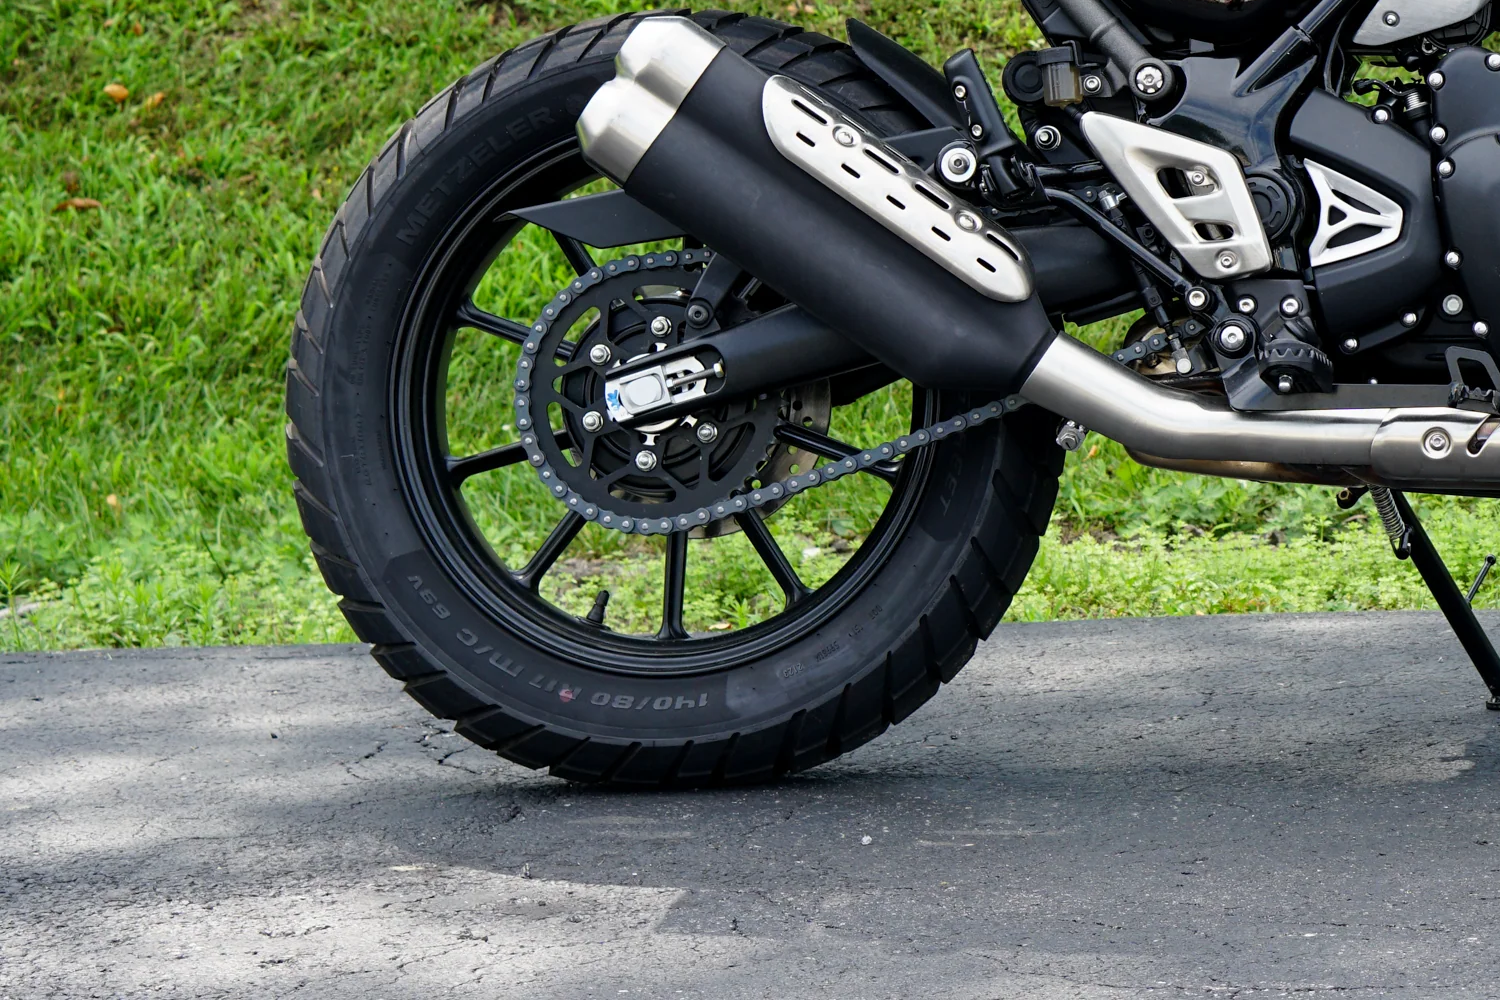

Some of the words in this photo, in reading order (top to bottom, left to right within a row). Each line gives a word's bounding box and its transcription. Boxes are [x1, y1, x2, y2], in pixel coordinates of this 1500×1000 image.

[396, 105, 556, 246] METZELER
[406, 574, 452, 620] 69V
[456, 627, 526, 678] M/C
[589, 692, 709, 712] 140/80
